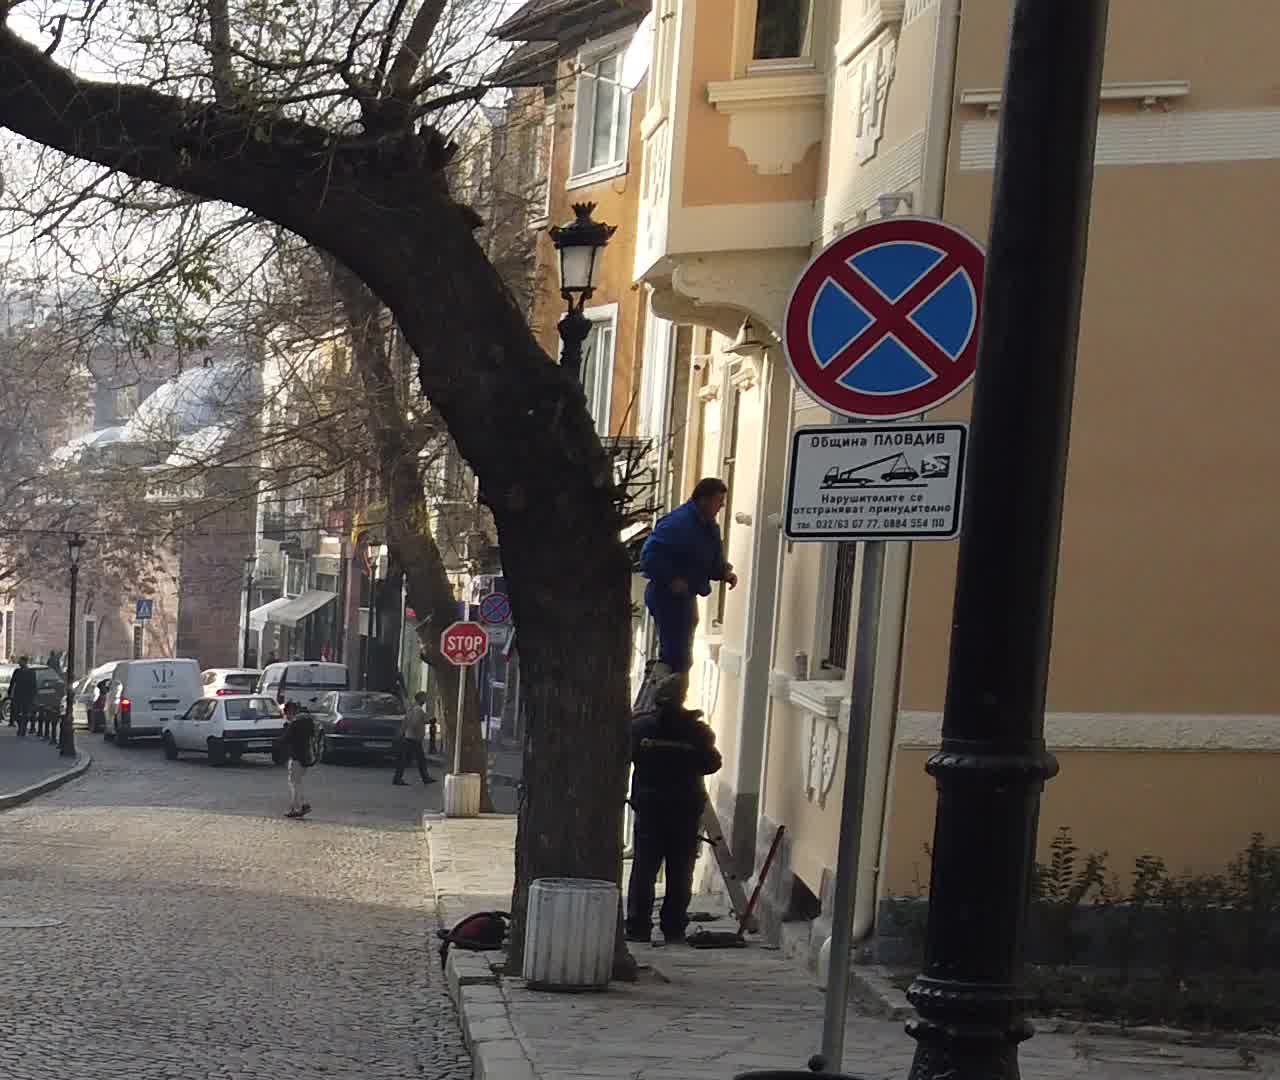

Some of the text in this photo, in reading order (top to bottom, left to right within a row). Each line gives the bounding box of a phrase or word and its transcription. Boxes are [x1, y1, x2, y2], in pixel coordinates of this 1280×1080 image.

[811, 433, 945, 448] Община ПЛОВДИВ
[821, 494, 924, 505] Нарушителите се
[793, 504, 952, 516] отстраняват принудително
[447, 636, 483, 651] STOP
